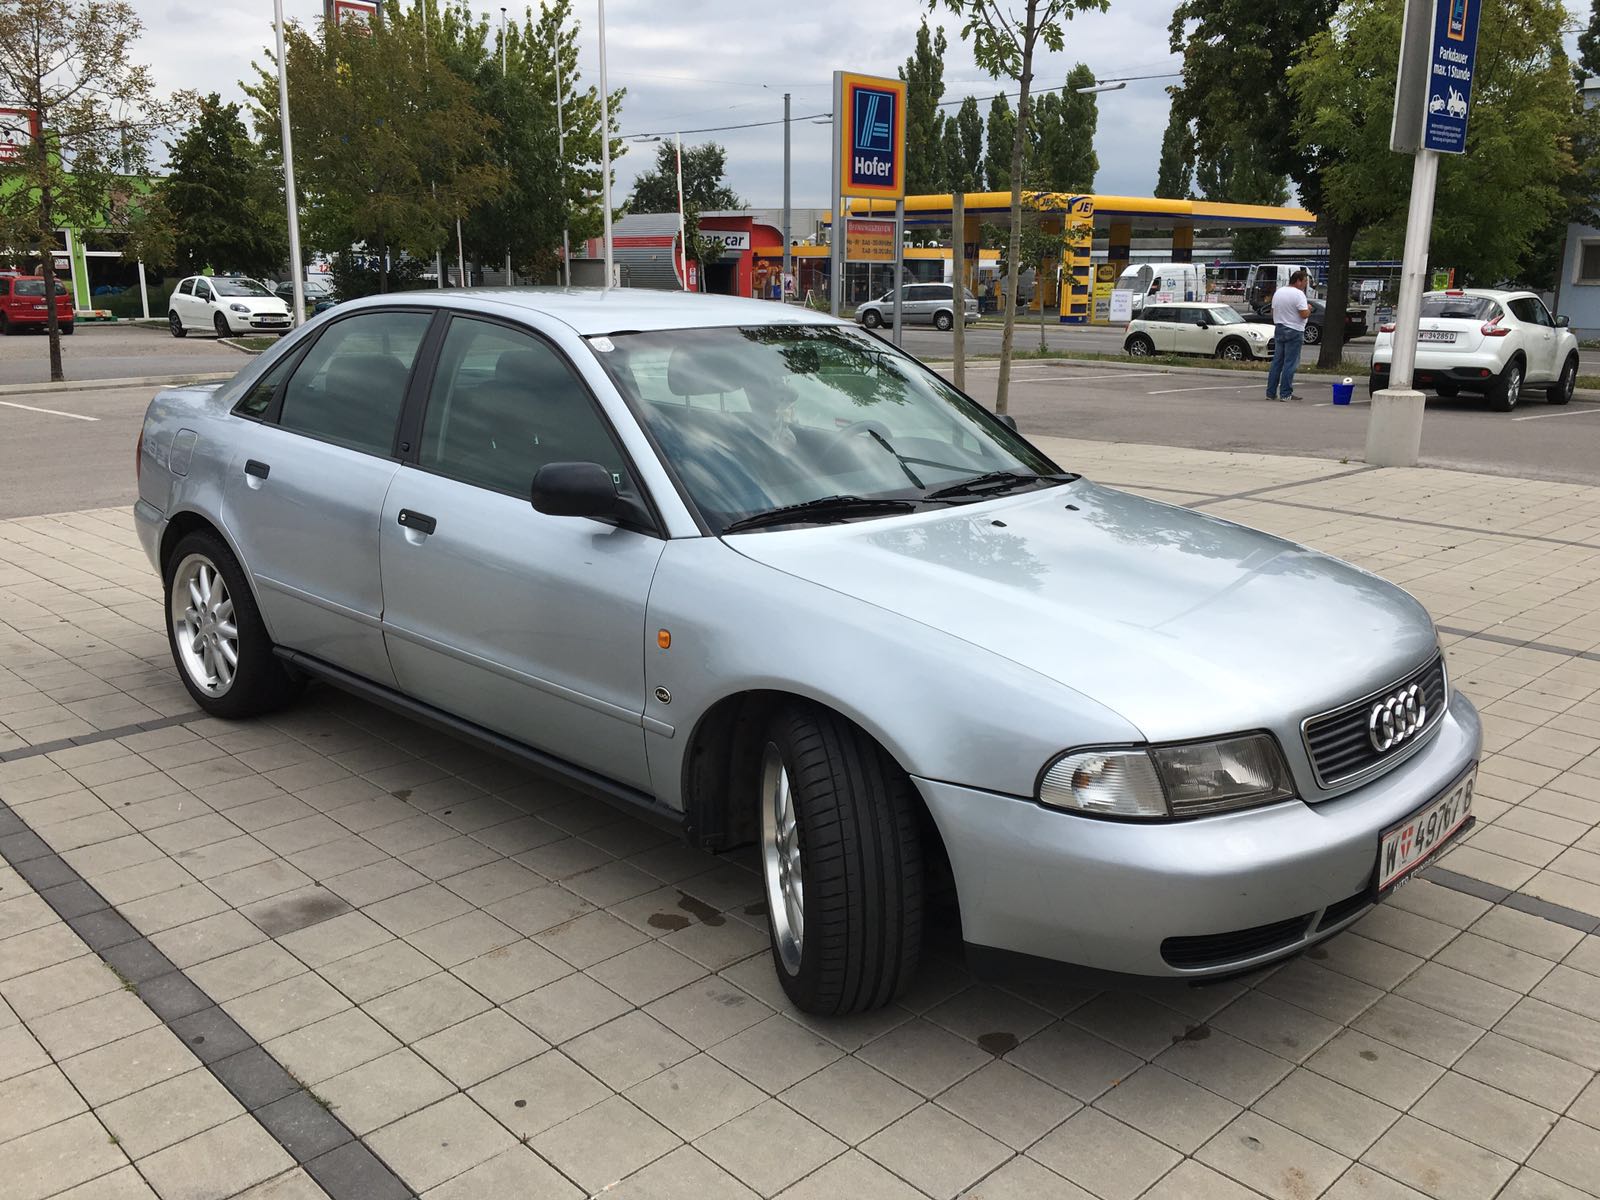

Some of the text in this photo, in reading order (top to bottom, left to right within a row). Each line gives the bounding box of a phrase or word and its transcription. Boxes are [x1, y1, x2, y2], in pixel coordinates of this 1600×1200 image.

[1451, 20, 1463, 31] Hofer
[1439, 46, 1469, 64] Parkdauer
[1433, 62, 1471, 81] max. 1 Stunde
[854, 156, 892, 177] Hofer
[1076, 202, 1093, 212] JET
[724, 235, 745, 247] car
[1428, 332, 1449, 340] 34285
[1386, 836, 1400, 877] W
[1414, 787, 1464, 855] 49767
[1463, 778, 1473, 814] B
